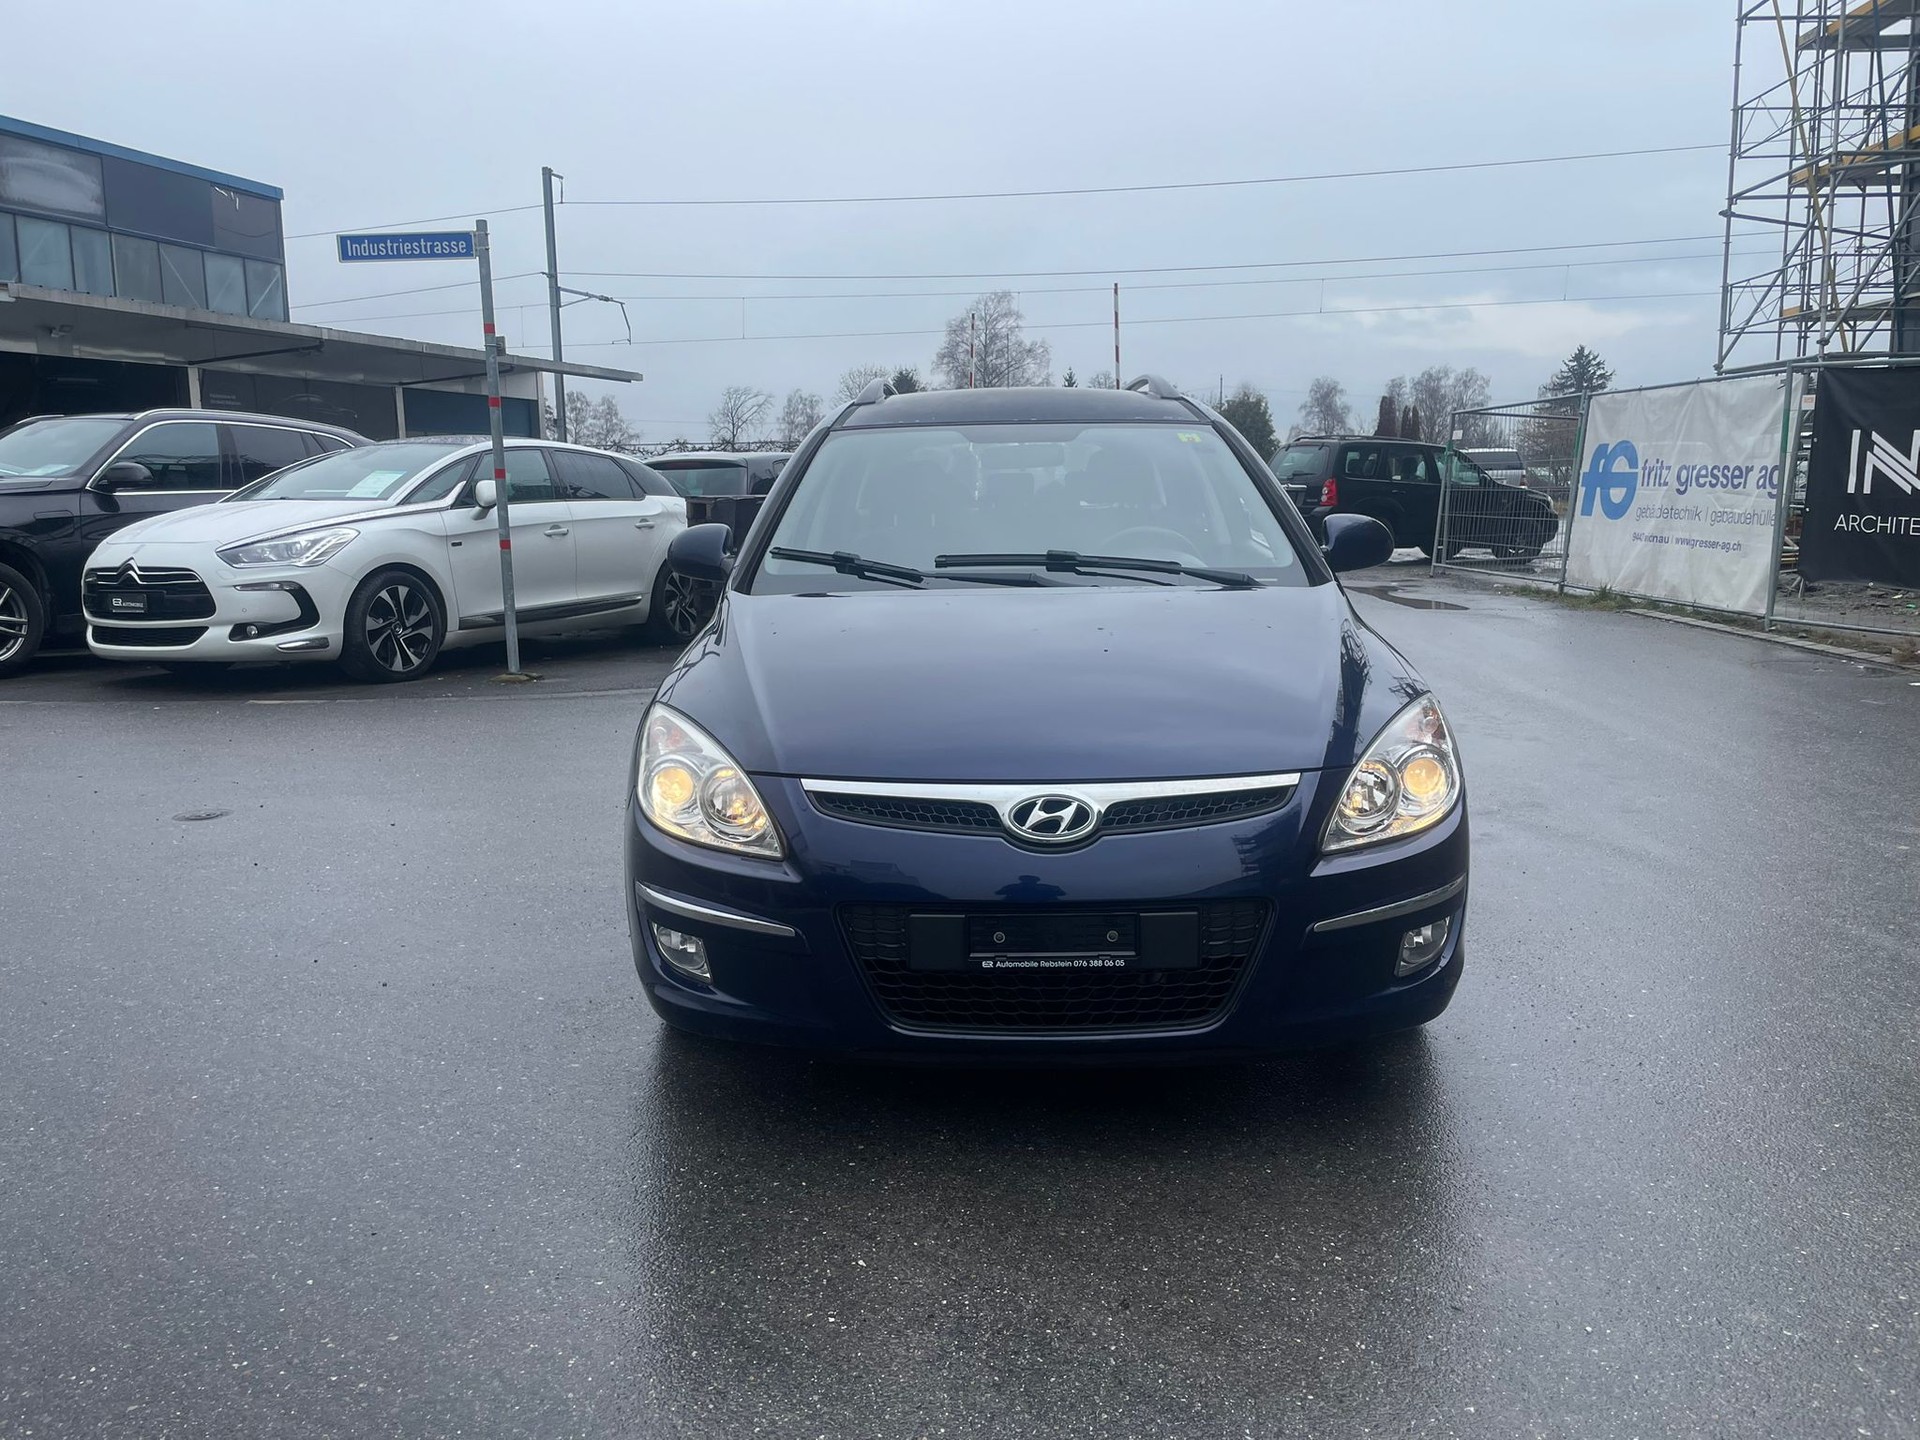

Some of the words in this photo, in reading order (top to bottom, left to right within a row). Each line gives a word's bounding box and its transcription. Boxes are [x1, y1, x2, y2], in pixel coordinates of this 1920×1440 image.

[346, 239, 467, 257] Industriestrasse
[1641, 458, 1672, 487] fritz
[1676, 463, 1754, 495] gresser
[1756, 464, 1780, 499] ag
[995, 960, 1039, 968] Automobile
[1040, 960, 1072, 968] Rebstein
[1073, 959, 1088, 967] 076
[1089, 959, 1103, 967] 388
[1104, 959, 1114, 967] 06
[1115, 959, 1125, 967] 05
